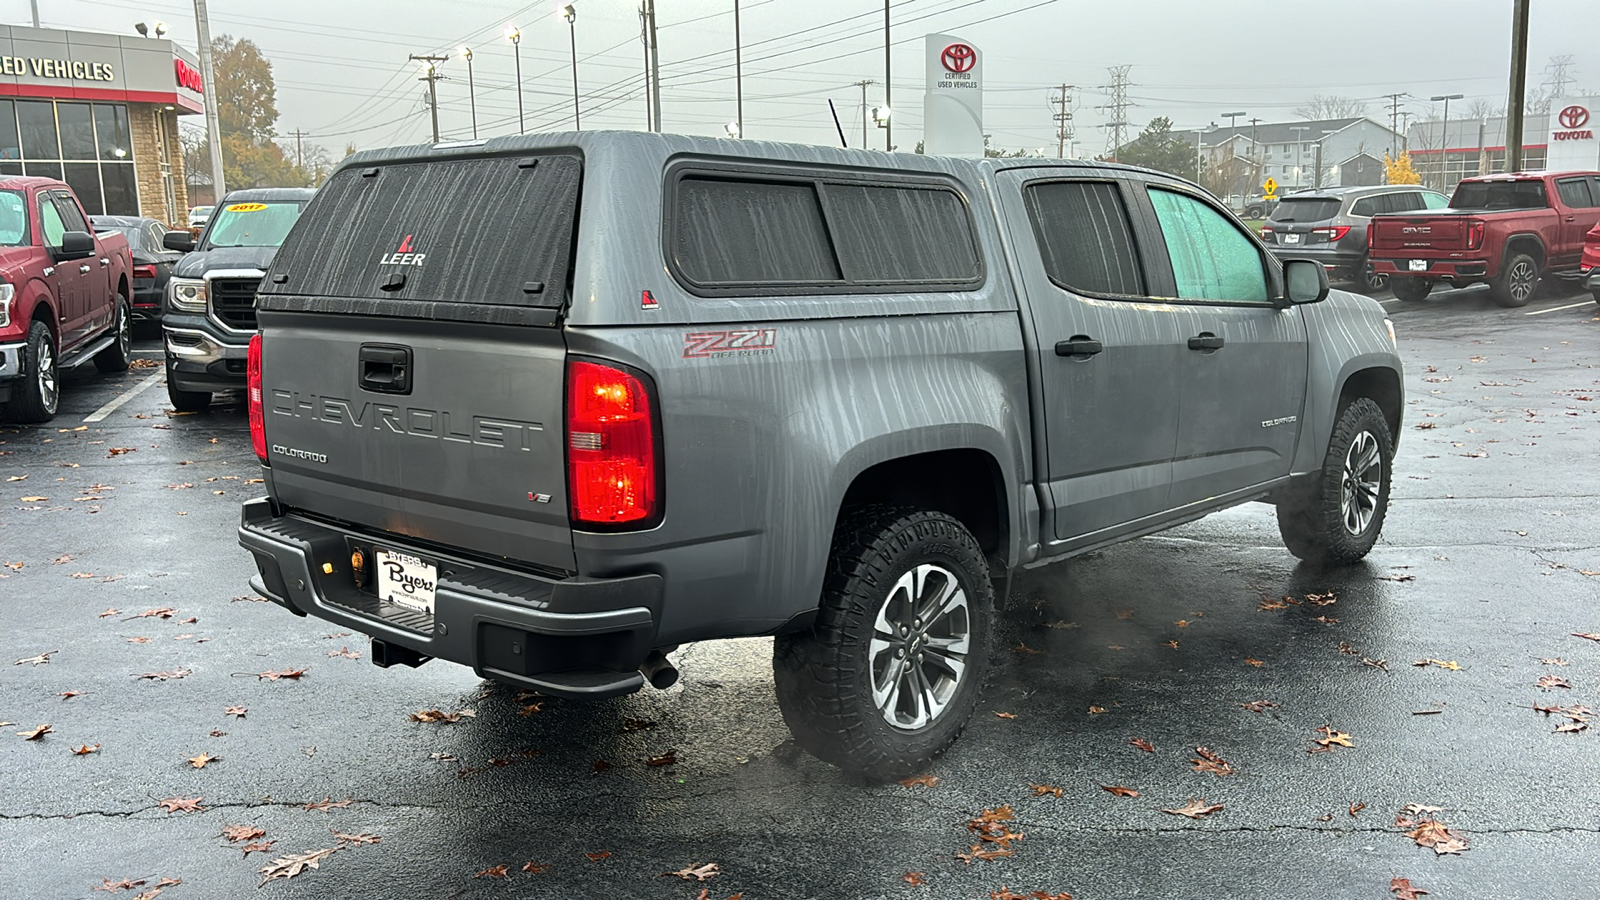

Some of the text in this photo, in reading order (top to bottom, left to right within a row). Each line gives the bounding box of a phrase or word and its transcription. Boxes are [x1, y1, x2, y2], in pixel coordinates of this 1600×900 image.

[0, 56, 114, 81] ED VEHICLES
[1552, 130, 1593, 141] TOYOTA
[231, 204, 264, 212] 2017
[1402, 226, 1431, 234] GMC
[380, 253, 426, 266] LEER
[682, 329, 777, 358] Z71
[711, 348, 774, 359] OFF ROAD
[272, 389, 543, 451] CHEVROLET
[1261, 415, 1297, 428] COLORADO
[272, 444, 327, 463] COLORADO
[527, 491, 551, 503] V6
[389, 552, 422, 568] BYERS
[383, 561, 433, 593] Byers
